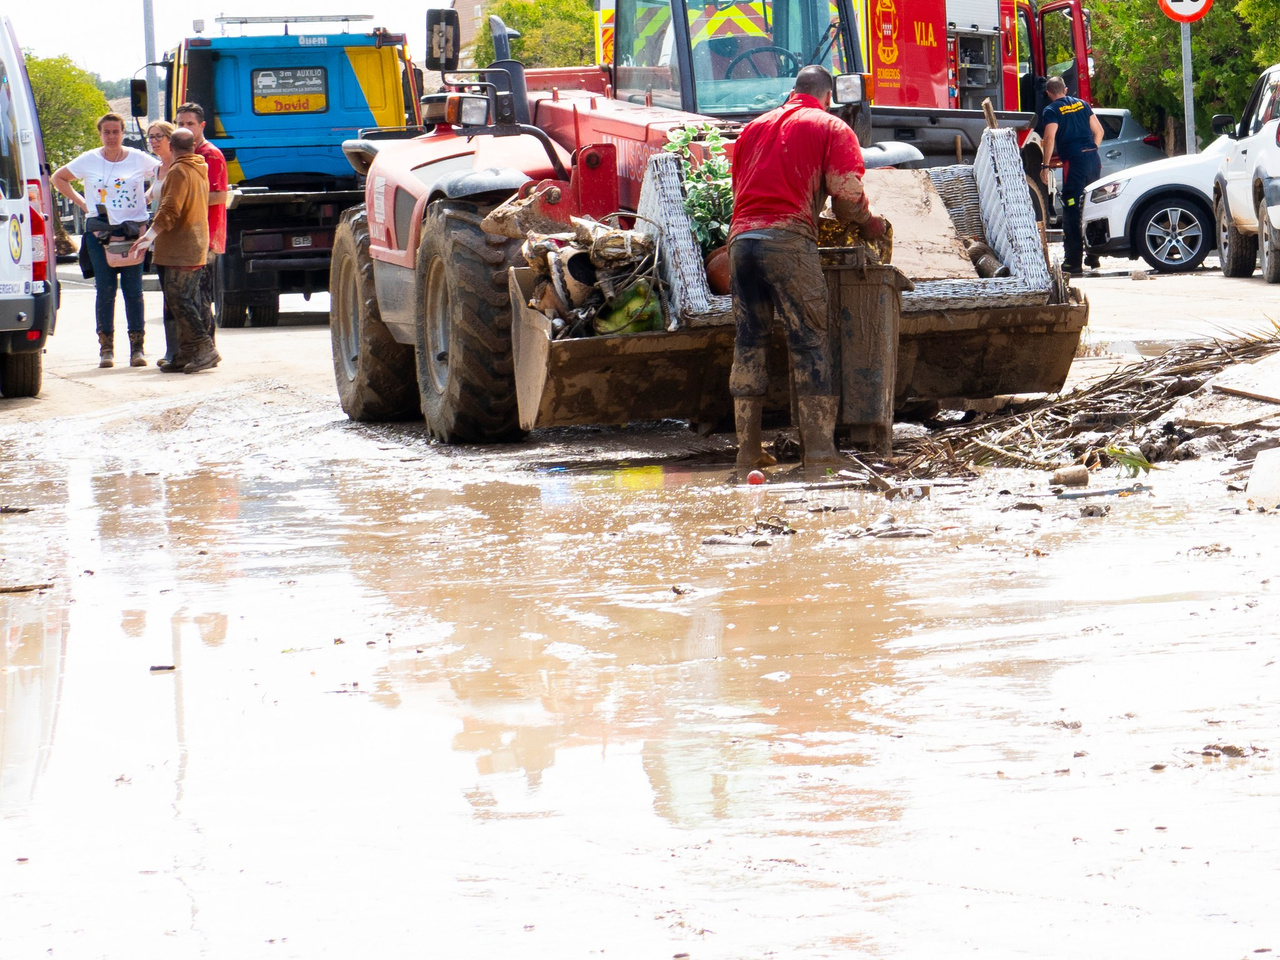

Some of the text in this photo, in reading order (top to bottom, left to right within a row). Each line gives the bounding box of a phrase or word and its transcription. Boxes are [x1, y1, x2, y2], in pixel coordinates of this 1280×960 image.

[914, 21, 937, 47] V.I.A.
[296, 69, 322, 77] AUXILIO
[274, 98, 309, 112] David
